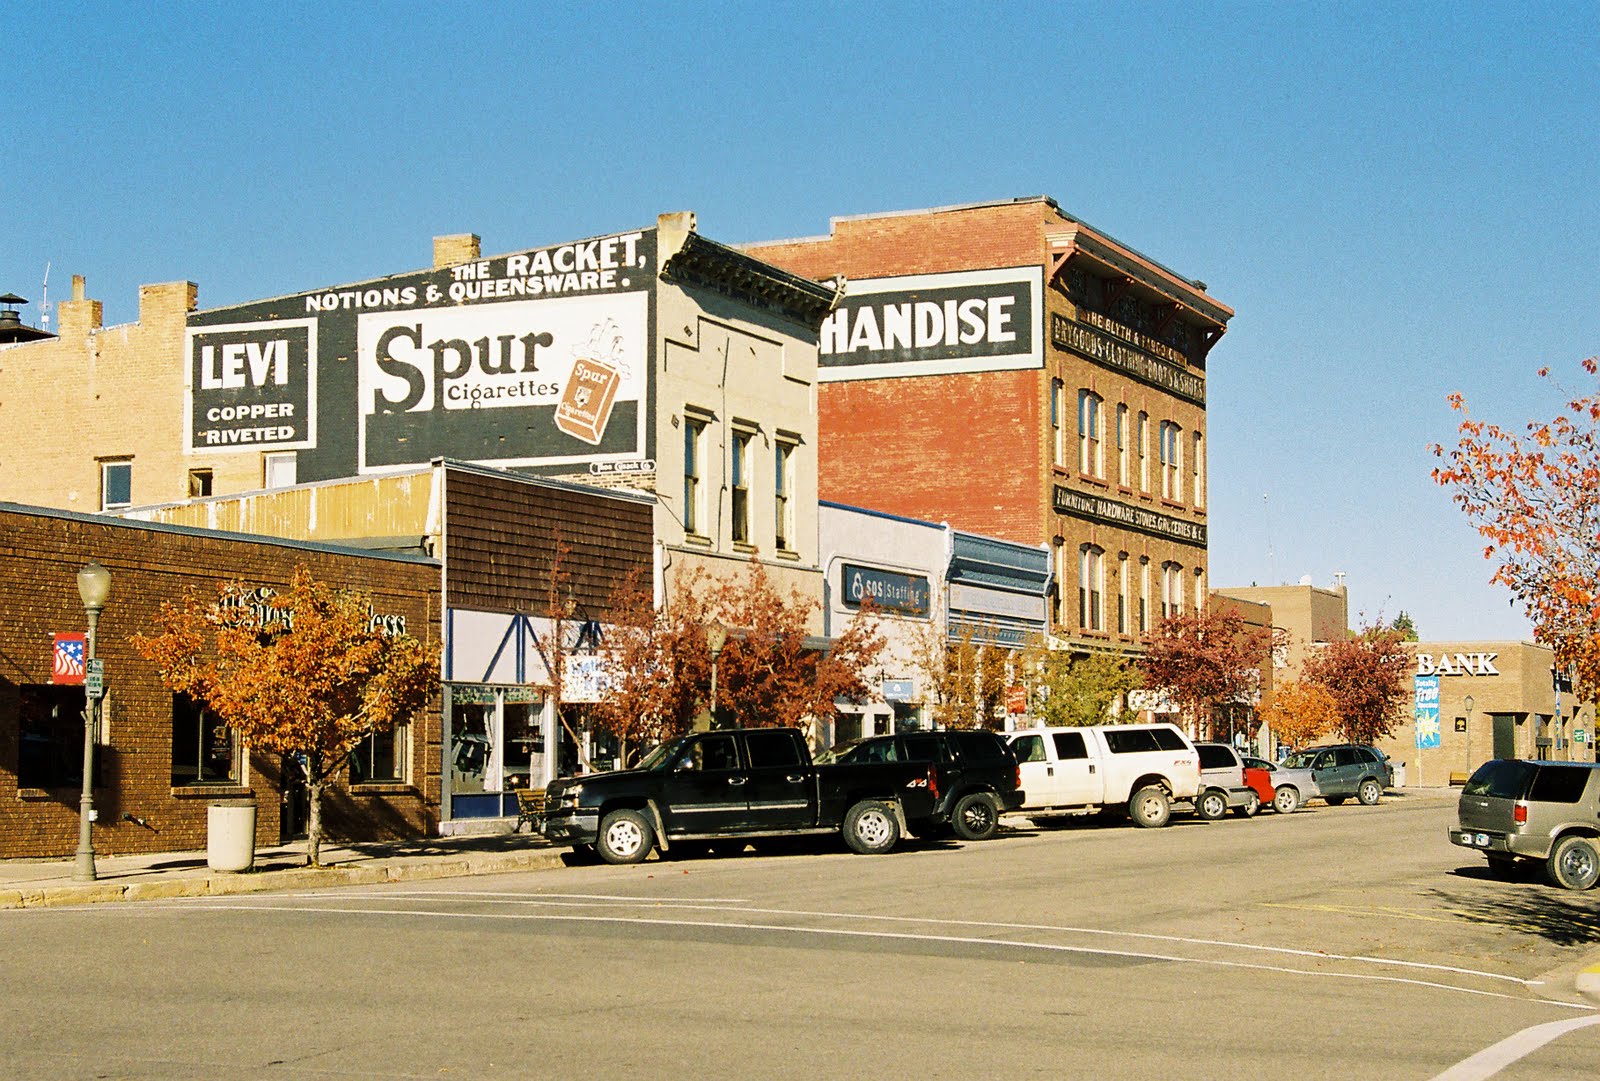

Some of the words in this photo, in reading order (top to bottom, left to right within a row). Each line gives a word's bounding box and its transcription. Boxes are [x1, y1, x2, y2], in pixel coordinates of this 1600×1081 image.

[452, 263, 489, 281] THE
[507, 232, 647, 277] RACKET,
[305, 287, 417, 312] NOTIONS
[426, 285, 443, 301] &
[817, 296, 1016, 354] HANDISE
[1087, 311, 1103, 328] THE
[1105, 316, 1132, 342] BLYTH
[201, 339, 289, 391] LEVI
[374, 323, 554, 414] Spur
[575, 363, 608, 385] Spur
[207, 403, 294, 422] COPPER
[205, 425, 295, 445] RIVETED
[866, 580, 883, 598] SOS
[887, 584, 920, 604] Staffing
[1416, 653, 1500, 676] BANK
[1416, 688, 1439, 702] free
